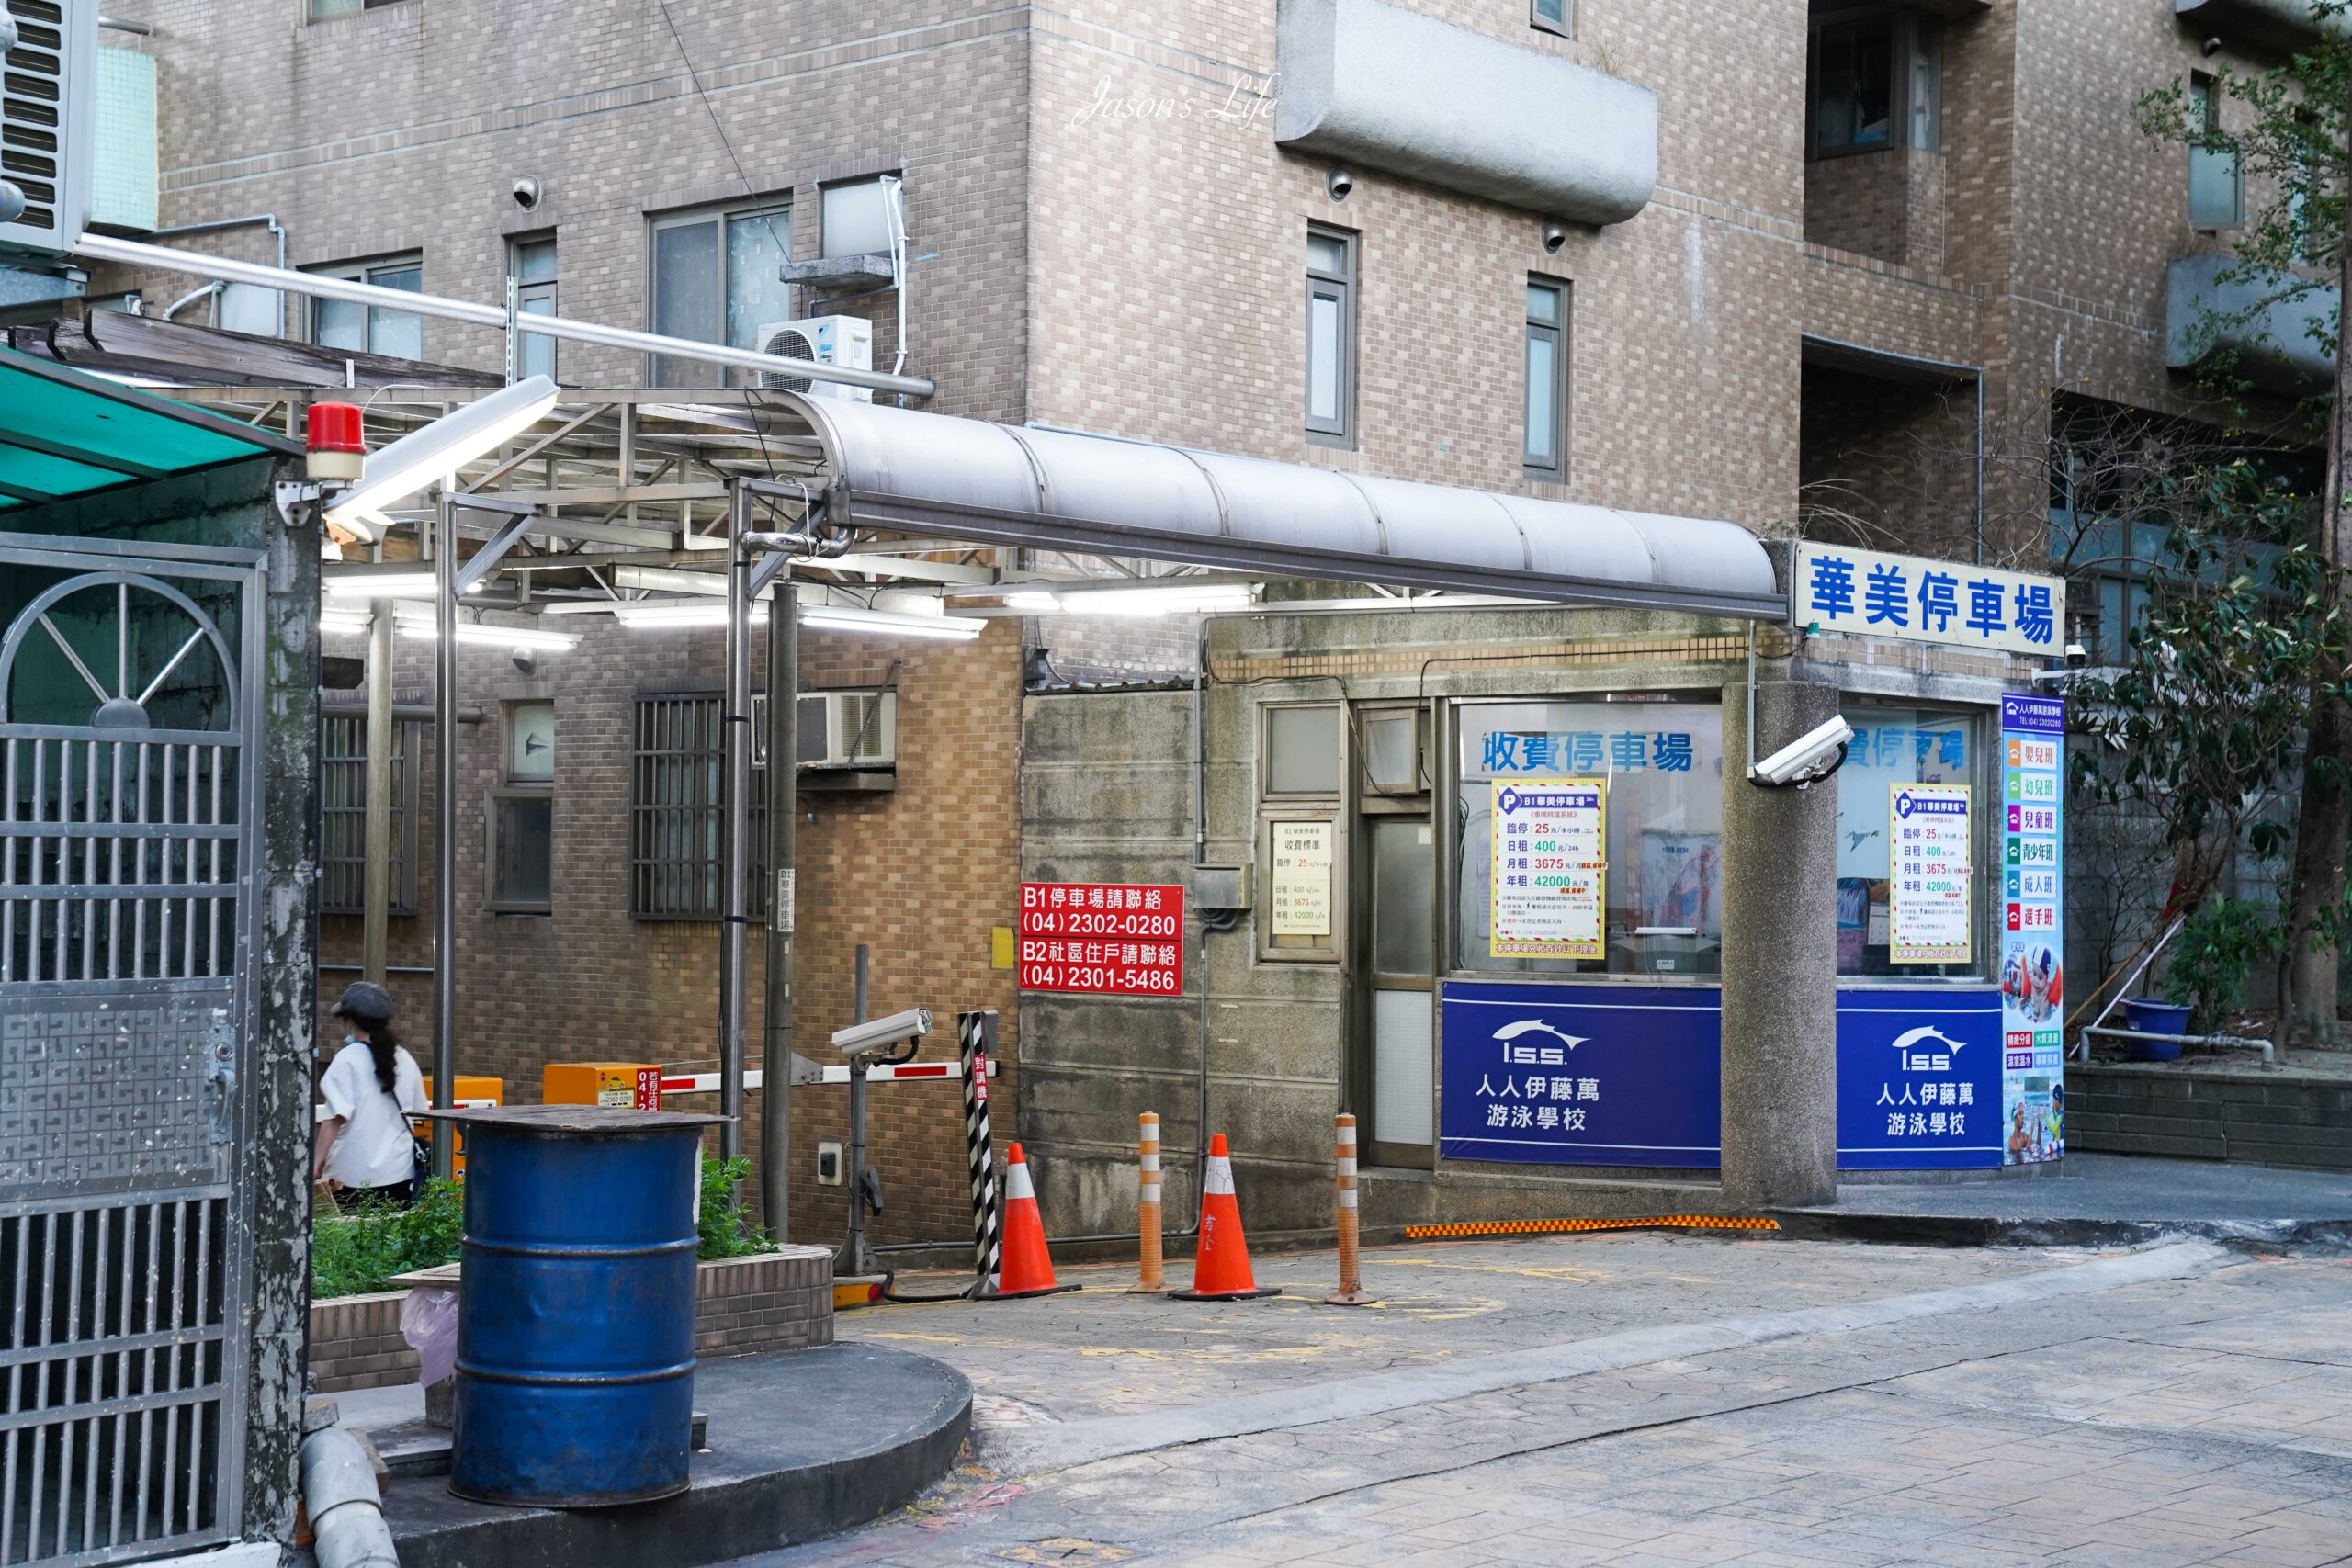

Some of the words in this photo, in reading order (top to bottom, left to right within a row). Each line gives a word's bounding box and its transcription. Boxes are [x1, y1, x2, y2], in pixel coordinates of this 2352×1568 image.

[1810, 555, 2053, 645] 華美停車場
[1482, 731, 1694, 773] 收費停車場
[2025, 746, 2053, 763] 嬰兒班
[2025, 778, 2053, 796] 幼兒班
[1535, 823, 1549, 834] 25
[2025, 811, 2053, 829] 兒童班
[1926, 829, 1937, 839] 25
[1284, 840, 1320, 850] 收費標準
[1534, 840, 1556, 852] 400
[1926, 846, 1941, 856] 400
[2023, 843, 2053, 861] 青少年班
[1298, 858, 1307, 867] 25
[1535, 859, 1564, 869] 3675
[1926, 863, 1946, 874] 3675
[1534, 876, 1570, 886] 42000
[1926, 881, 1951, 892] 42000
[2024, 876, 2052, 893] 成人班
[1023, 886, 1162, 910] B1停車場請聯絡
[2024, 908, 2052, 925] 選手班
[1023, 941, 1176, 966] B2社區住戶請聯絡
[974, 1056, 988, 1099] 對講機
[1476, 1074, 1600, 1101] 人人伊藤萬
[1876, 1082, 1973, 1106] 人人伊藤萬
[1487, 1104, 1586, 1131] 游泳學校
[1886, 1112, 1965, 1136] 游泳學校
